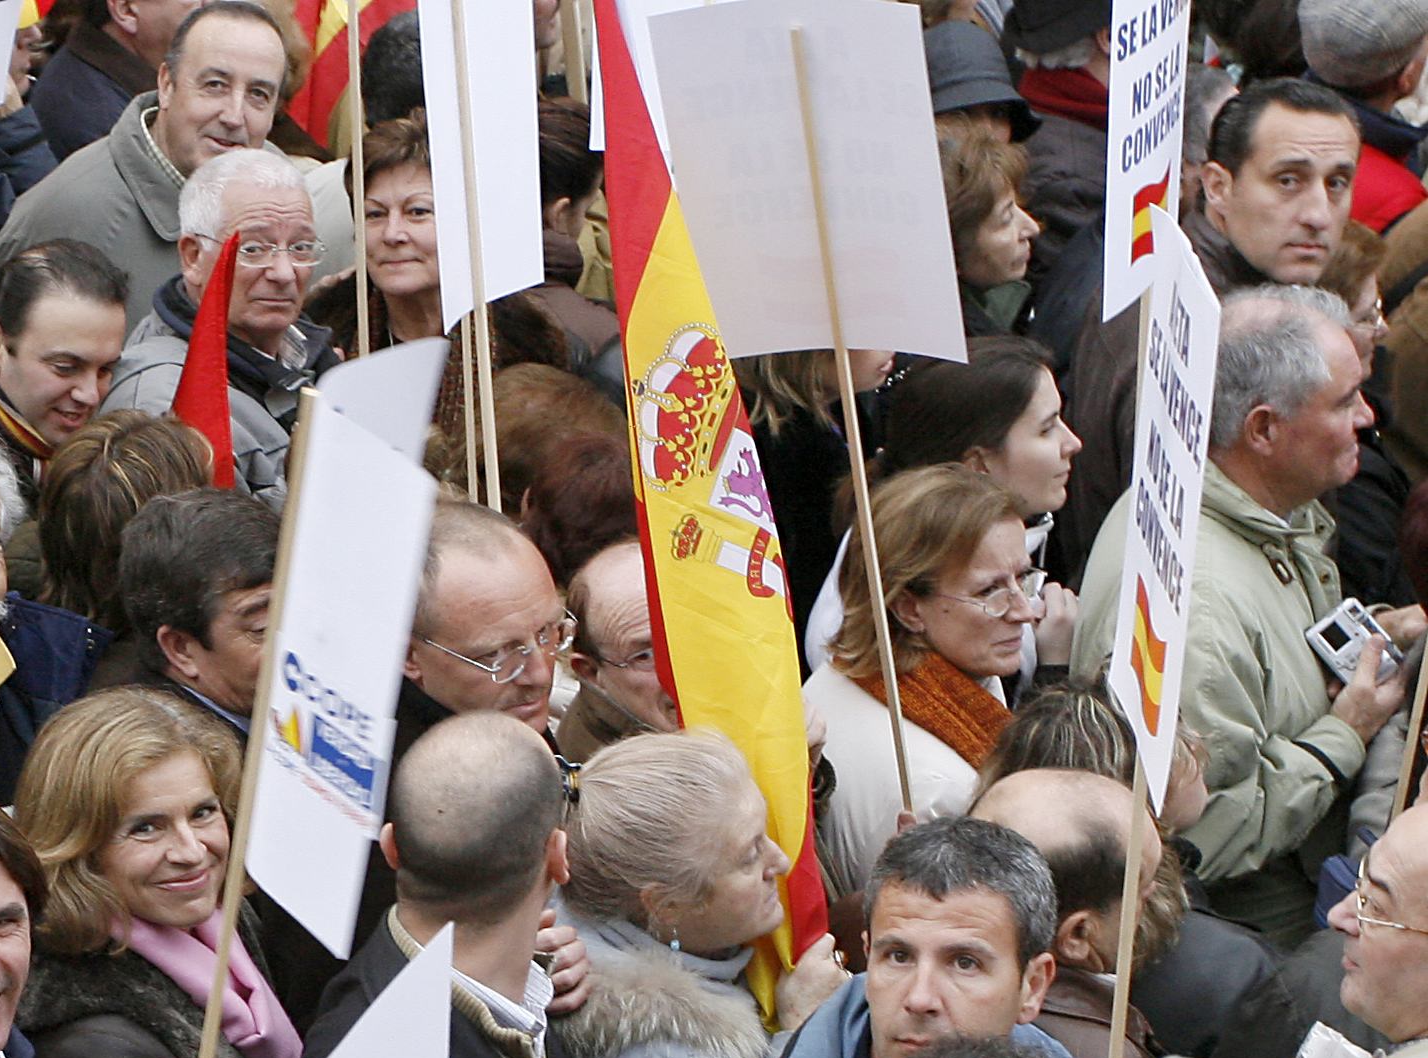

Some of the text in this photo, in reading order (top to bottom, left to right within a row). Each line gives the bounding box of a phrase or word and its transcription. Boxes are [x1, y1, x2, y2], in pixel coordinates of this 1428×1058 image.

[1117, 16, 1137, 62] SE
[1141, 4, 1158, 47] LA
[1132, 41, 1181, 119] NO SE LA
[1122, 85, 1181, 174] CONVENCE
[1136, 477, 1184, 617] CONVENCE
